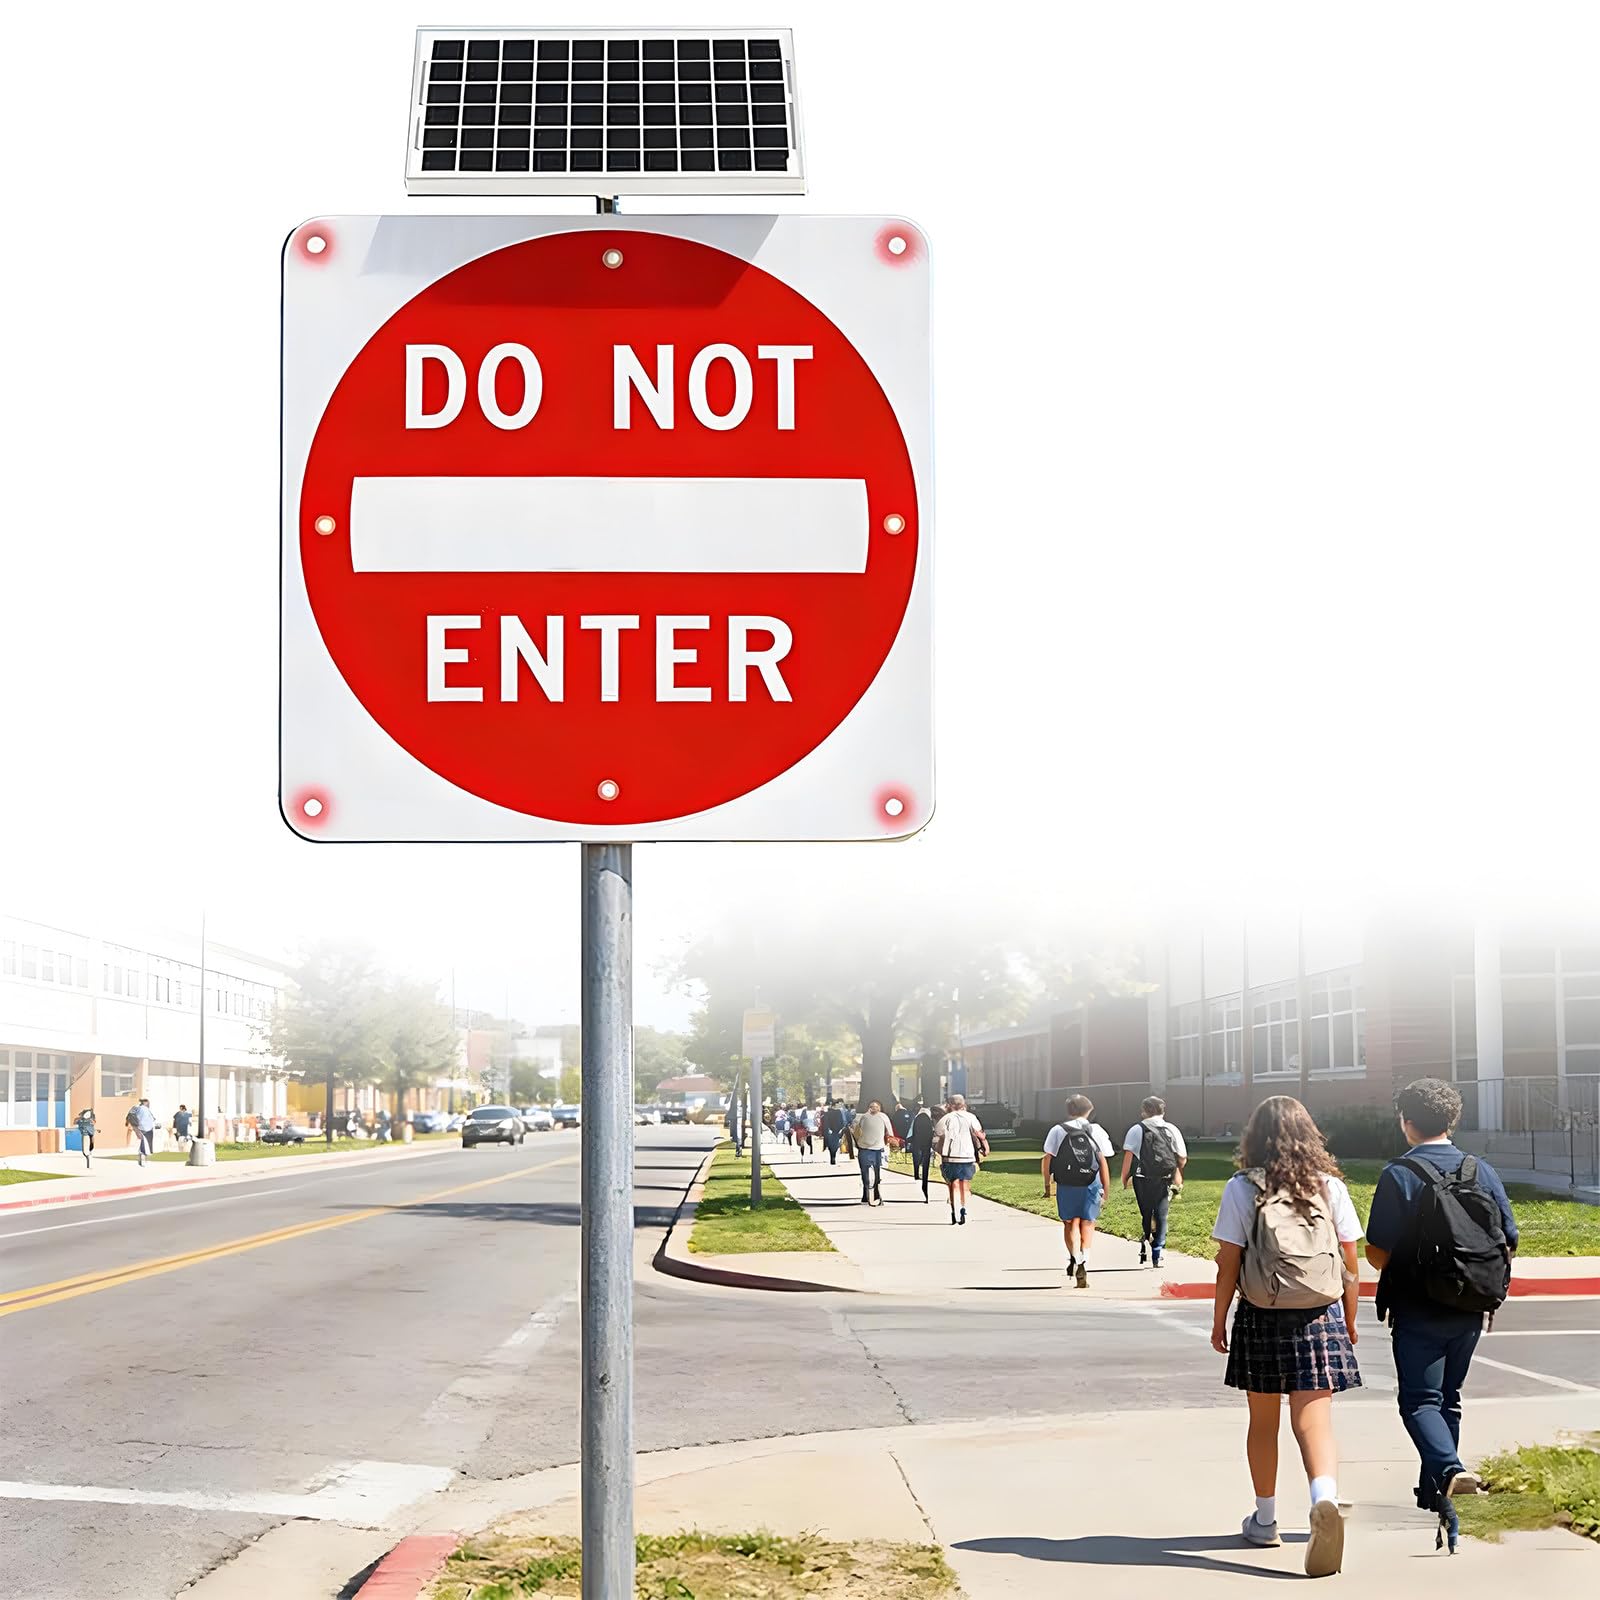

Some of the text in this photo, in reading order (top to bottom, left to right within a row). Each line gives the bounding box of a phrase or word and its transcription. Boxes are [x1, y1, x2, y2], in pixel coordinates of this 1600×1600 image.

[405, 343, 814, 430] DO NOT
[426, 615, 793, 703] ENTER
